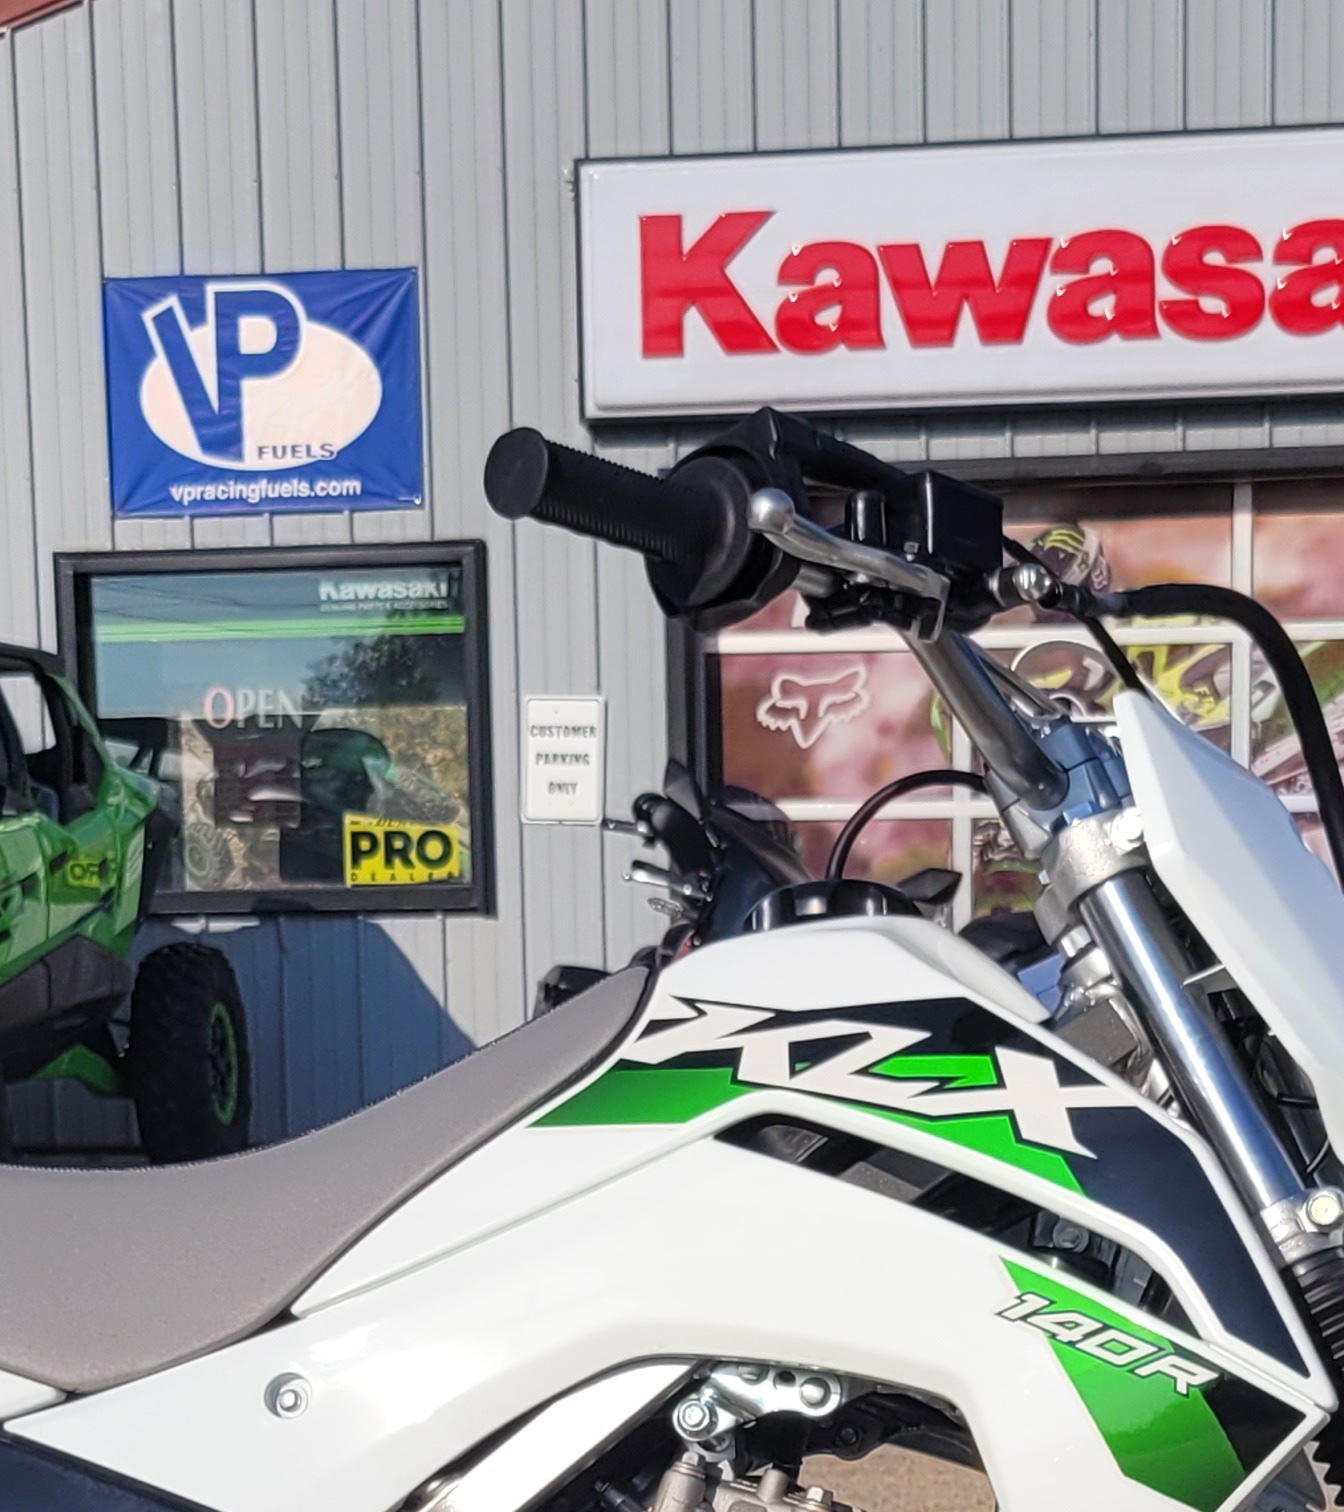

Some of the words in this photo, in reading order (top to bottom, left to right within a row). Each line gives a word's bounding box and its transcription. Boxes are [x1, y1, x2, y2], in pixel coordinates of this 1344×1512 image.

[142, 283, 306, 463] VP
[257, 443, 336, 460] FUELS
[170, 477, 362, 506] vpracingfuels.com
[319, 580, 448, 600] Kawasaki
[204, 688, 304, 728] OPEN
[530, 725, 597, 738] CUSTOMER
[536, 752, 590, 766] PARKING
[548, 781, 578, 795] ONLY
[350, 830, 453, 870] PRO
[995, 1291, 1224, 1398] 140R
